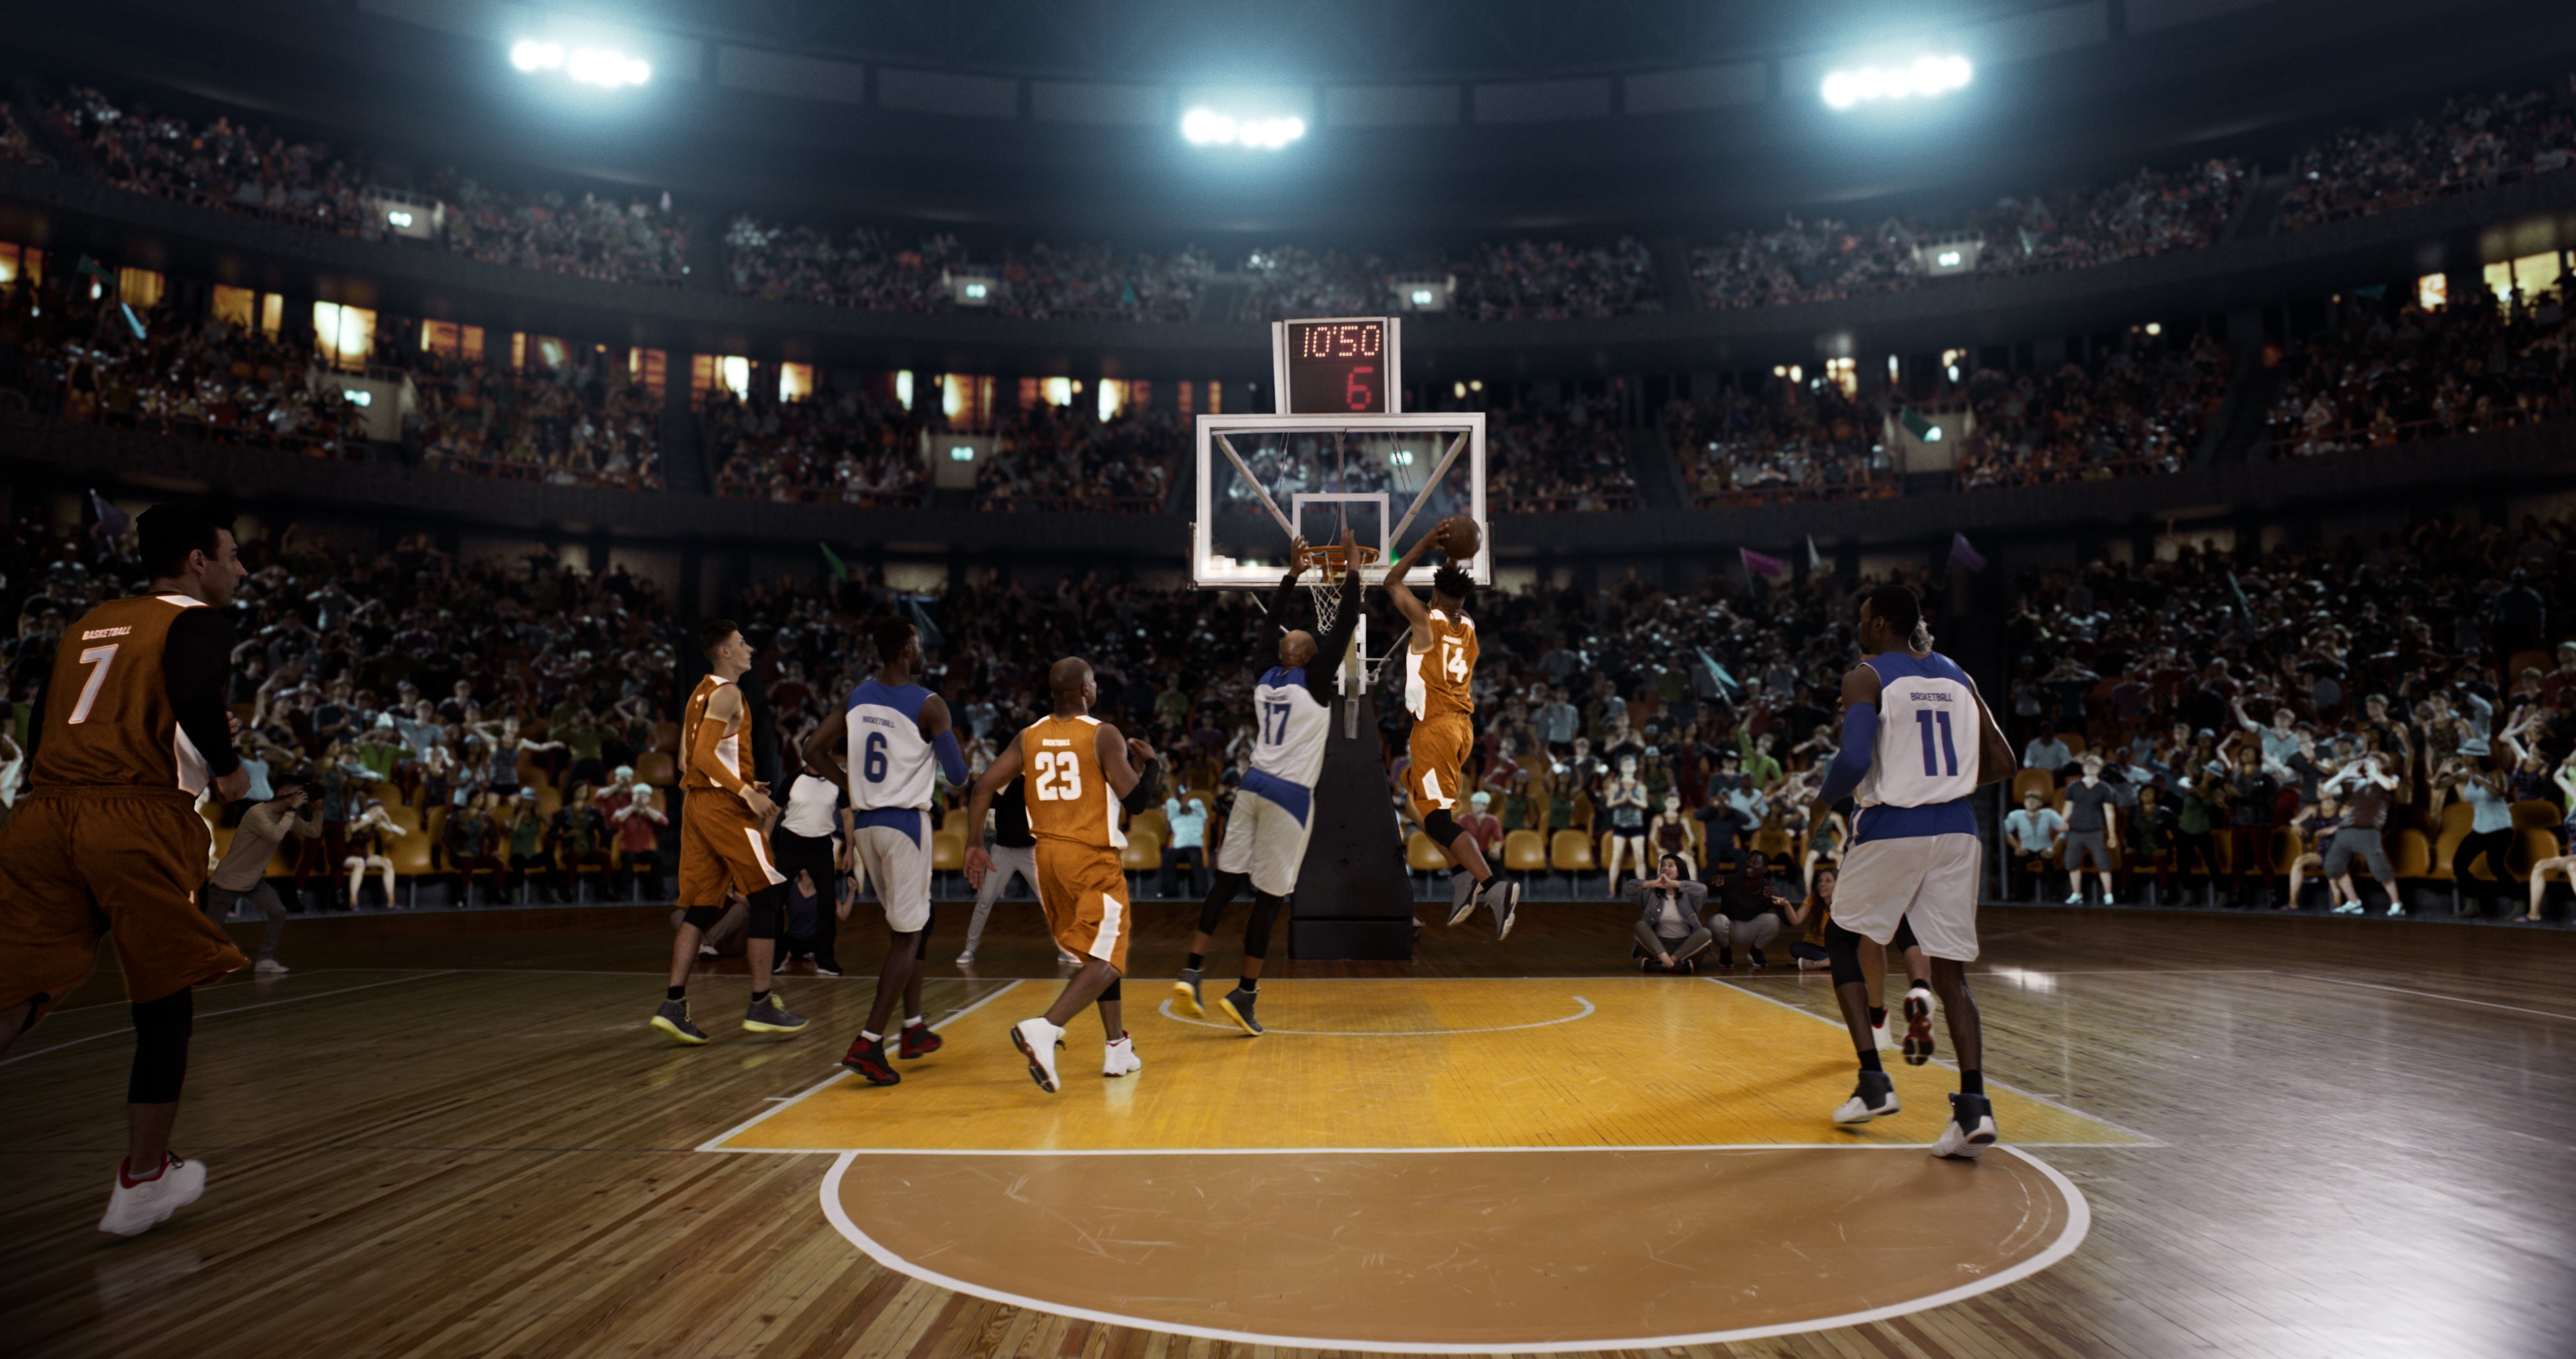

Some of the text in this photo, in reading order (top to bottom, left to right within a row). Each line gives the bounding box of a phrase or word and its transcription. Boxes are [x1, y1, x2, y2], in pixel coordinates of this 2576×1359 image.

[1346, 366, 1374, 410] 6
[82, 626, 131, 640] BASKETBALL
[68, 643, 119, 724] 7
[1442, 643, 1468, 683] 14
[1910, 692, 1953, 702] BASKETBALL
[862, 716, 895, 728] BASKETBALL
[1264, 702, 1291, 746] 17
[1916, 710, 1958, 776] 11
[863, 731, 888, 784] 6
[1034, 751, 1082, 801] 23
